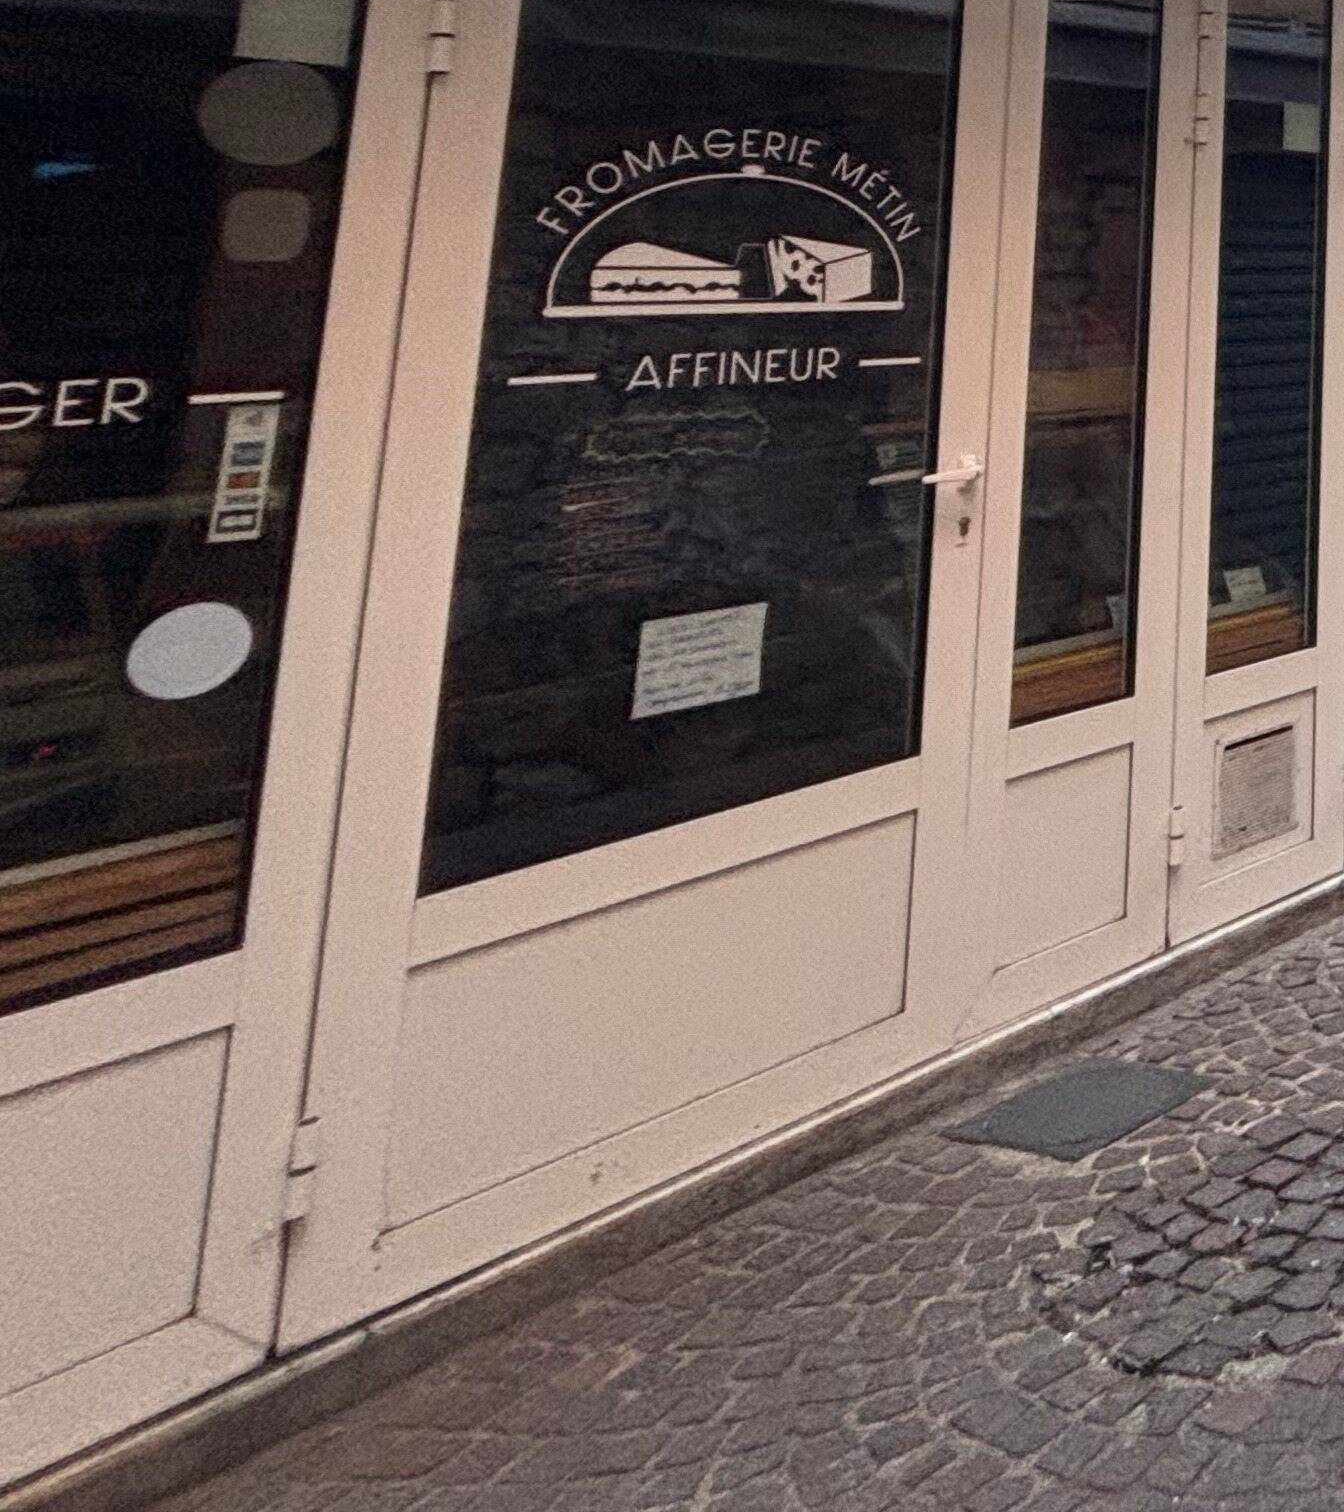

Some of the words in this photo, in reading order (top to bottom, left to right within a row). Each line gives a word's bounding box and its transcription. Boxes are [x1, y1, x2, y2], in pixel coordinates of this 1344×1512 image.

[536, 129, 821, 236] FROMAGERIE
[831, 152, 922, 243] MÉTIN
[625, 347, 841, 392] AFFINEUR
